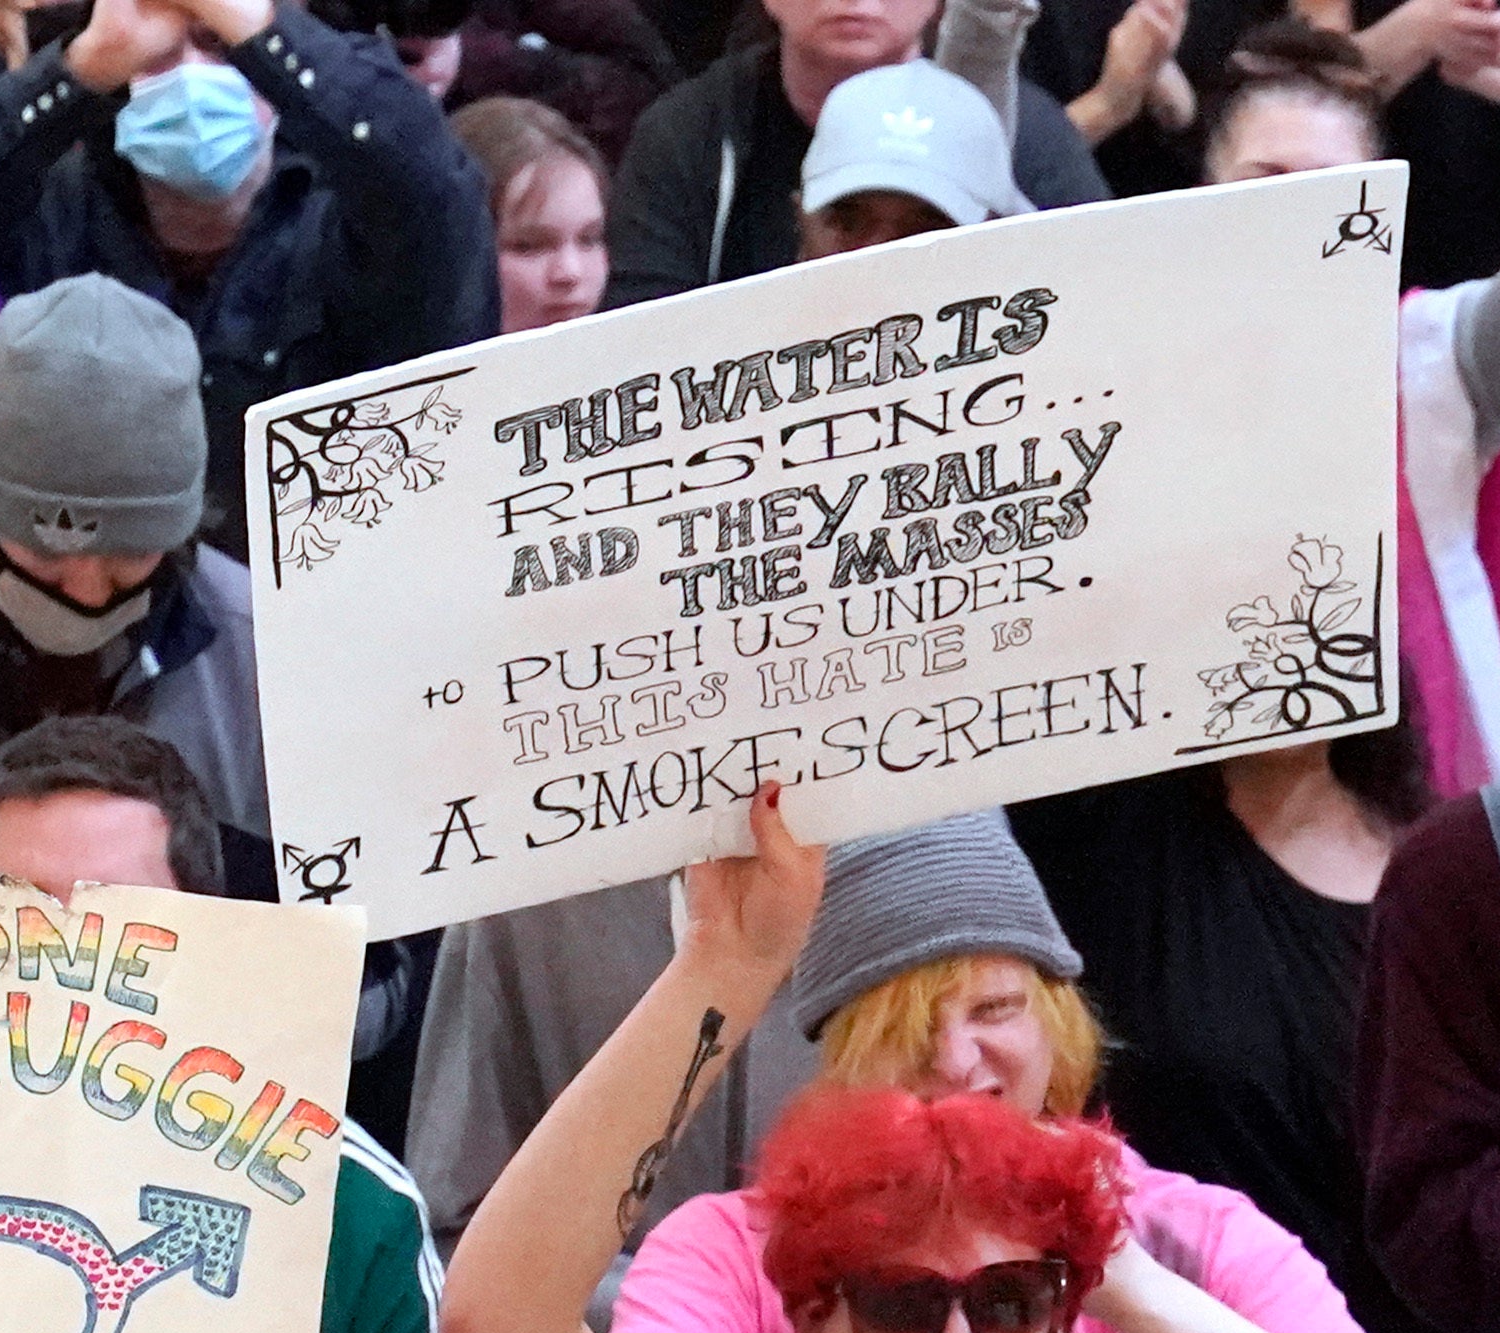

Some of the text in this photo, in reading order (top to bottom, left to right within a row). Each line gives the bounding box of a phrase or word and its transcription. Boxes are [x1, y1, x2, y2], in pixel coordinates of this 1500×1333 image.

[494, 287, 1059, 477] THE WATER IS
[504, 420, 1122, 597] AND THEY RALLY
[659, 488, 1093, 618] THE MASSES
[422, 678, 465, 711] to
[500, 625, 706, 704] PUSH
[729, 602, 827, 659] US
[503, 616, 1035, 767] THIS HATE IS
[420, 794, 499, 876] A
